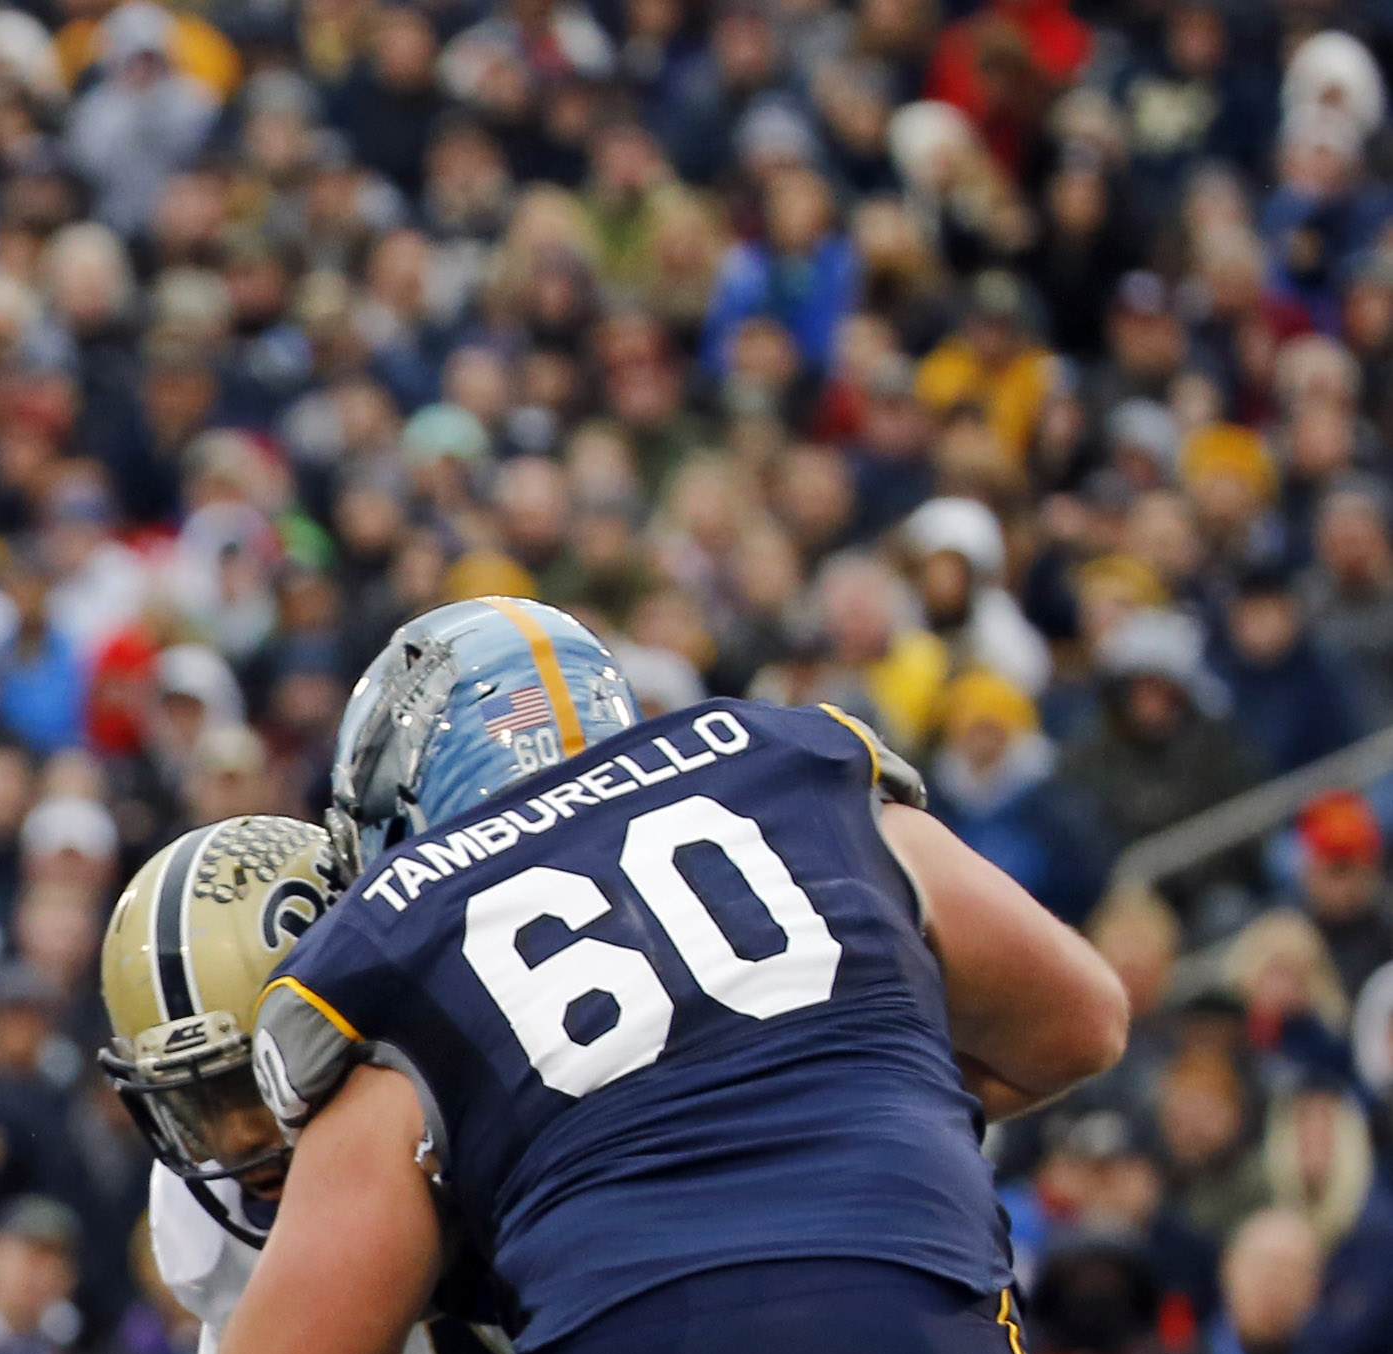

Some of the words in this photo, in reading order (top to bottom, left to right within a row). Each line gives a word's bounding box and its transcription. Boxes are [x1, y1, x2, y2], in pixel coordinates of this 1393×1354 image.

[362, 710, 752, 914] TAMBURELLO
[513, 726, 561, 773] 60
[461, 794, 844, 1099] 60
[164, 1021, 206, 1048] ACC
